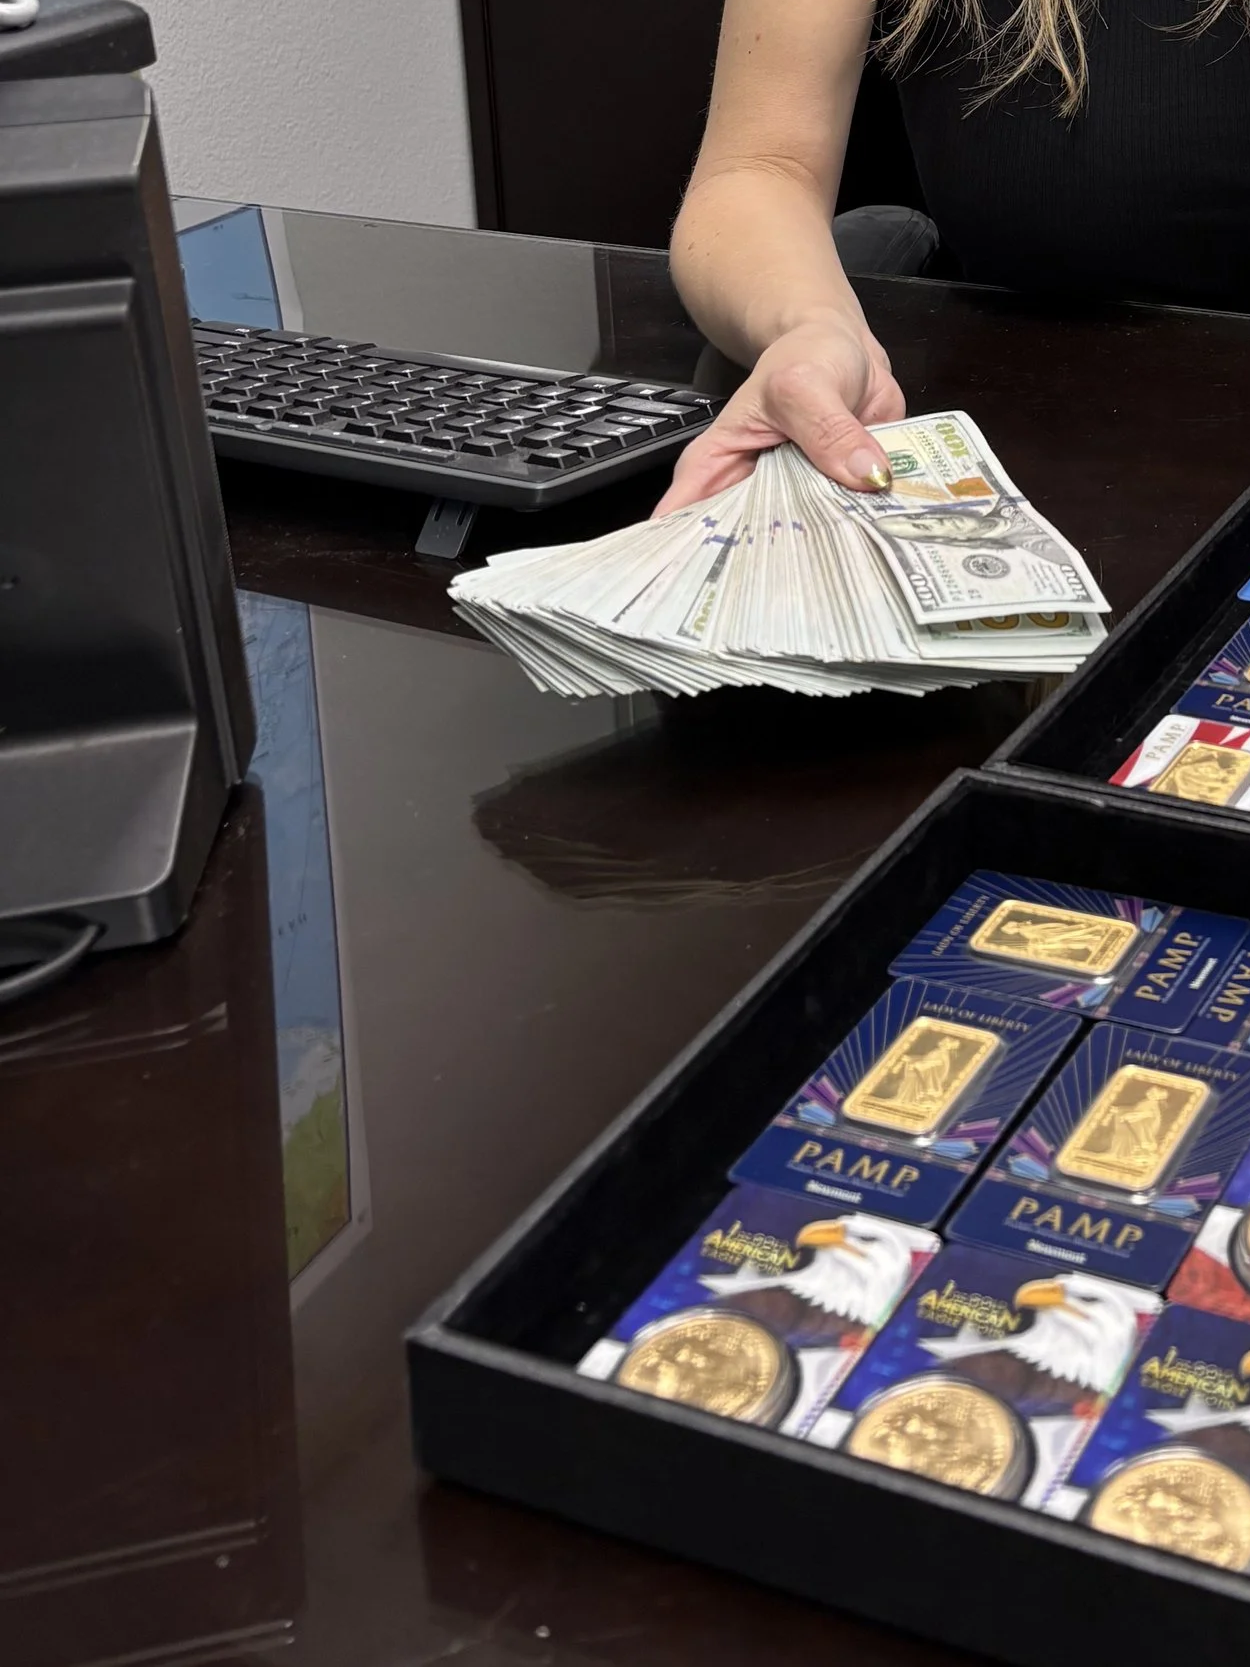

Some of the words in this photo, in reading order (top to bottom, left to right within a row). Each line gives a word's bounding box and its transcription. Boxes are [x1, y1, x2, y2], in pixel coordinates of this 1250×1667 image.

[1145, 722, 1188, 762] PAMP
[1134, 931, 1200, 1002] PAMP
[923, 1001, 956, 1016] LADY
[957, 1008, 977, 1022] OF
[978, 1013, 1034, 1033] LIBERTY
[1125, 1048, 1159, 1065] LADY
[1162, 1056, 1184, 1071] OF
[1185, 1062, 1241, 1083] LIBERTY
[793, 1140, 921, 1190] PAMP
[1010, 1196, 1145, 1250] PAMP
[703, 1228, 801, 1270] AMERICAN
[917, 1289, 1021, 1332] AMERICAN
[1141, 1355, 1250, 1403] AMERICAN
